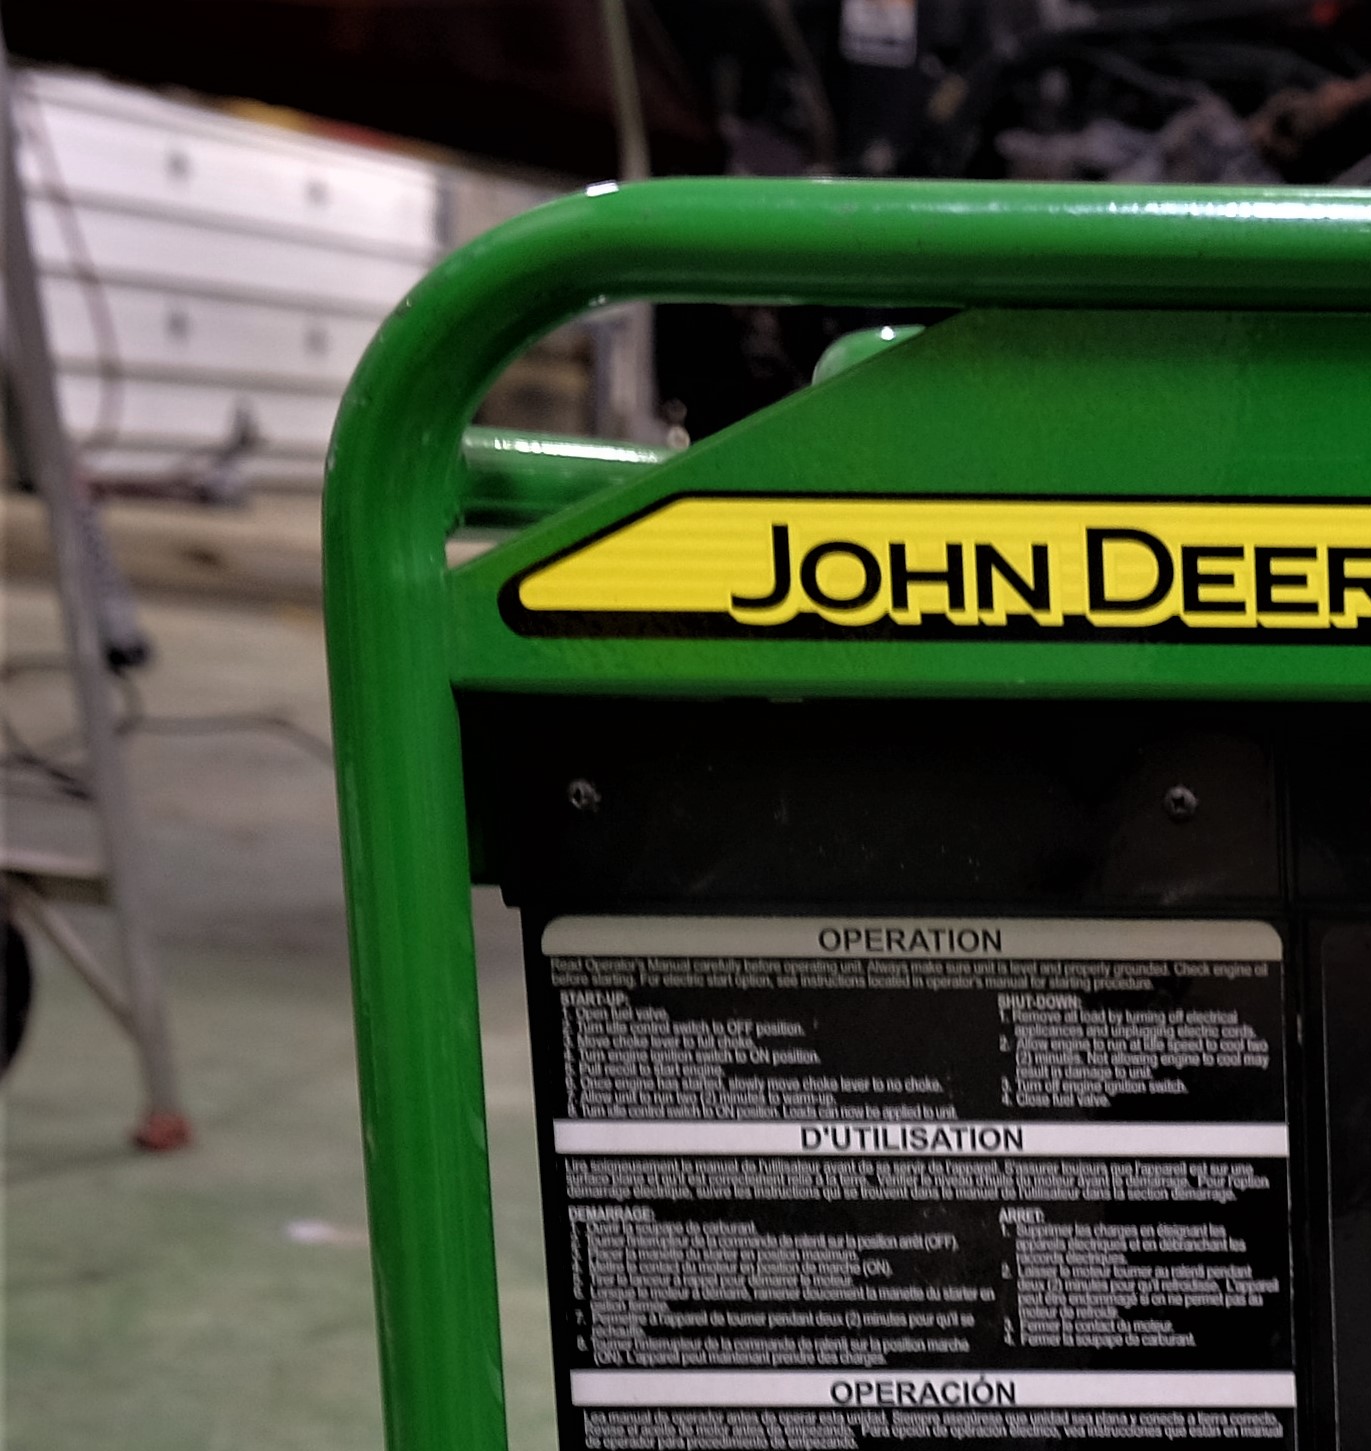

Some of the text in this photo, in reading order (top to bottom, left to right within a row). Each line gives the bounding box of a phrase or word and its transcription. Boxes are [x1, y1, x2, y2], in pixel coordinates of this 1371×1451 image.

[731, 523, 1052, 615] JOHN
[818, 928, 1002, 952] OPERATION
[801, 1127, 1023, 1150] D'UTILISATION
[830, 1373, 1016, 1406] OPERACIÓN
